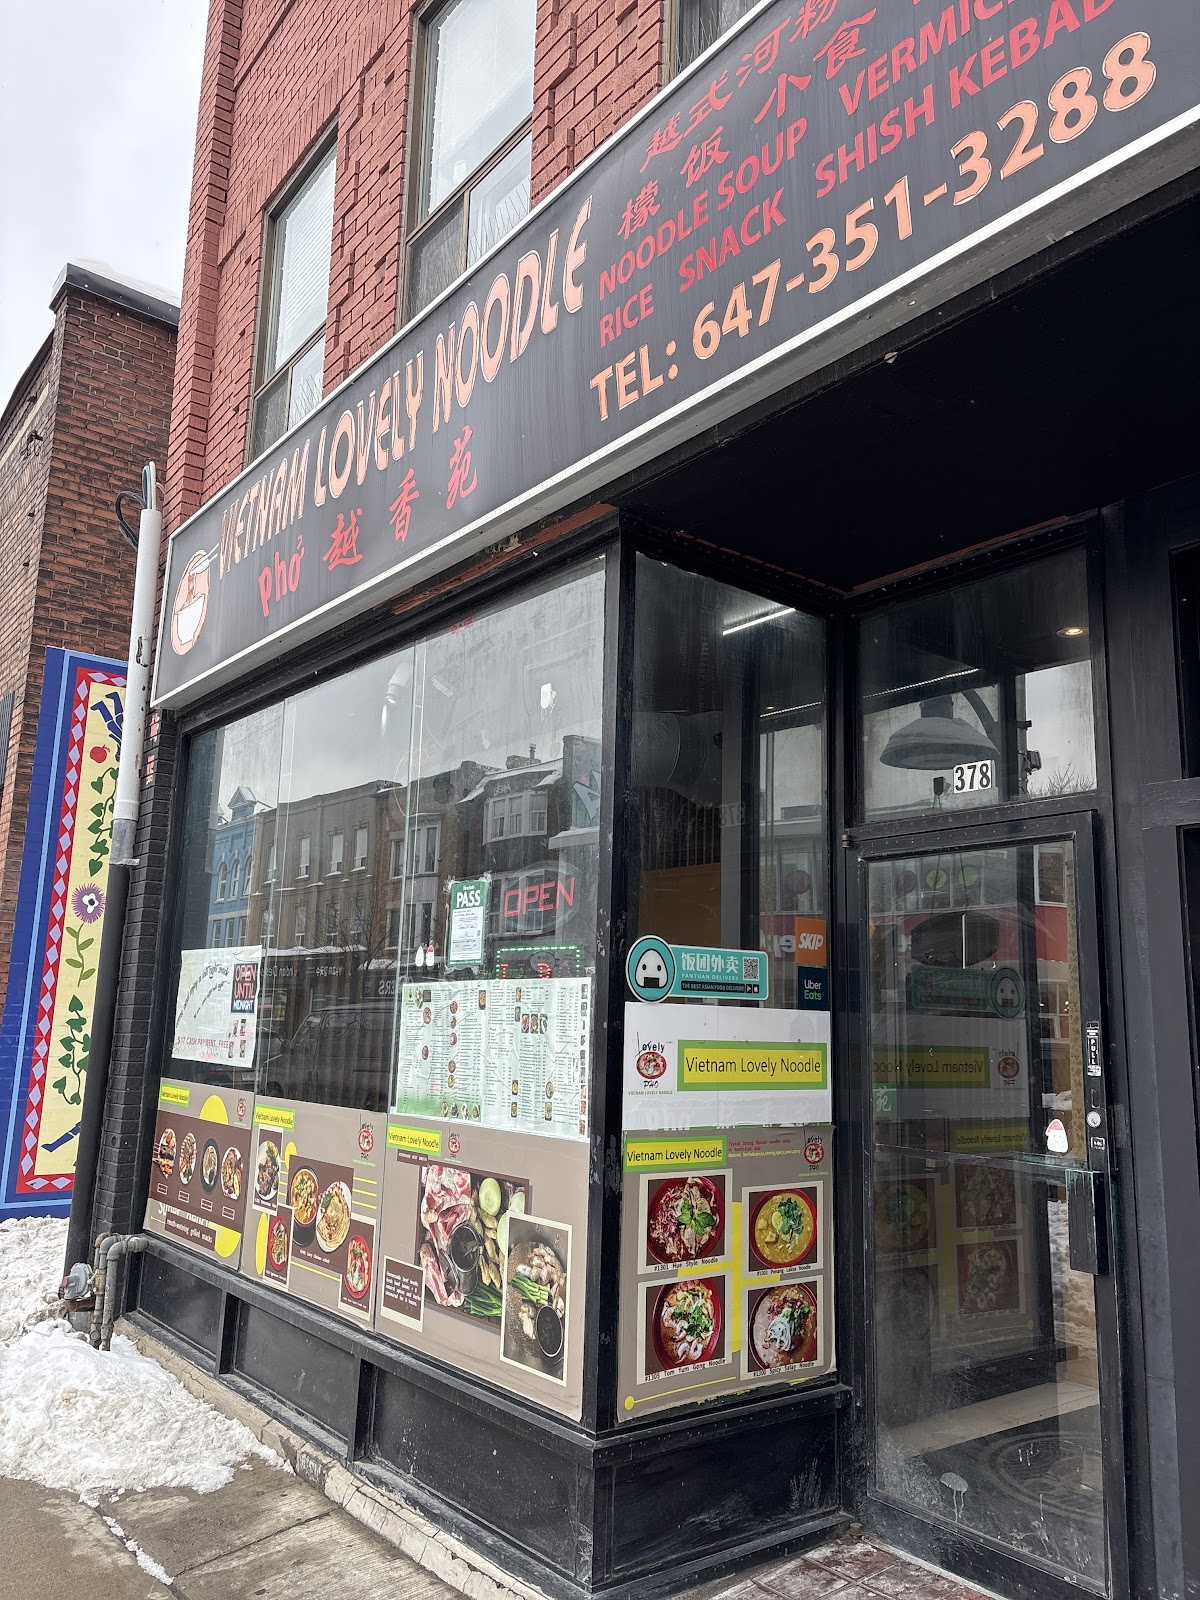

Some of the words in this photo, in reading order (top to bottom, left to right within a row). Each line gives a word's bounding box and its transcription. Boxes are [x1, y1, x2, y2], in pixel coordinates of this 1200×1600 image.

[599, 190, 709, 302] NOODLE
[717, 117, 807, 211] SOUP
[600, 284, 654, 348] RICE
[679, 187, 787, 294] SNACK
[815, 84, 935, 198] SHISH
[590, 340, 679, 422] TEL:
[693, 31, 1158, 360] 647-351-3288
[219, 438, 311, 580] VIETNAM
[314, 350, 423, 508] LOVELY
[432, 195, 593, 434] NOODLE
[955, 763, 991, 791] 378
[456, 889, 481, 909] PASS
[504, 877, 576, 918] OPEN
[798, 932, 824, 950] SKIP
[681, 952, 739, 974] 饭团外卖
[235, 964, 257, 981] OPEN
[234, 982, 255, 999] UNTIL
[804, 979, 822, 990] Uber
[804, 990, 822, 1000] Eats
[233, 1000, 254, 1011] MIDNIGHT
[686, 1056, 737, 1073] Vietnam
[741, 1057, 777, 1077] Lovely
[780, 1057, 821, 1073] Noodle
[255, 1110, 269, 1120] Vietnam
[269, 1112, 279, 1124] Lovely
[280, 1116, 293, 1126] Noodle
[389, 1132, 407, 1143] Vietnam
[407, 1135, 421, 1147] Lovely
[422, 1138, 439, 1148] Noodle
[627, 1147, 663, 1164] Vietnam
[665, 1147, 692, 1164] Lovely
[694, 1146, 723, 1160] Noodle
[672, 1262, 683, 1270] Hue
[685, 1260, 698, 1268] Style
[645, 1373, 661, 1382] #1305
[664, 1369, 675, 1377] Tom
[679, 1366, 690, 1375] Yum
[709, 1358, 726, 1366] Noodle
[769, 1367, 782, 1375] Spicy
